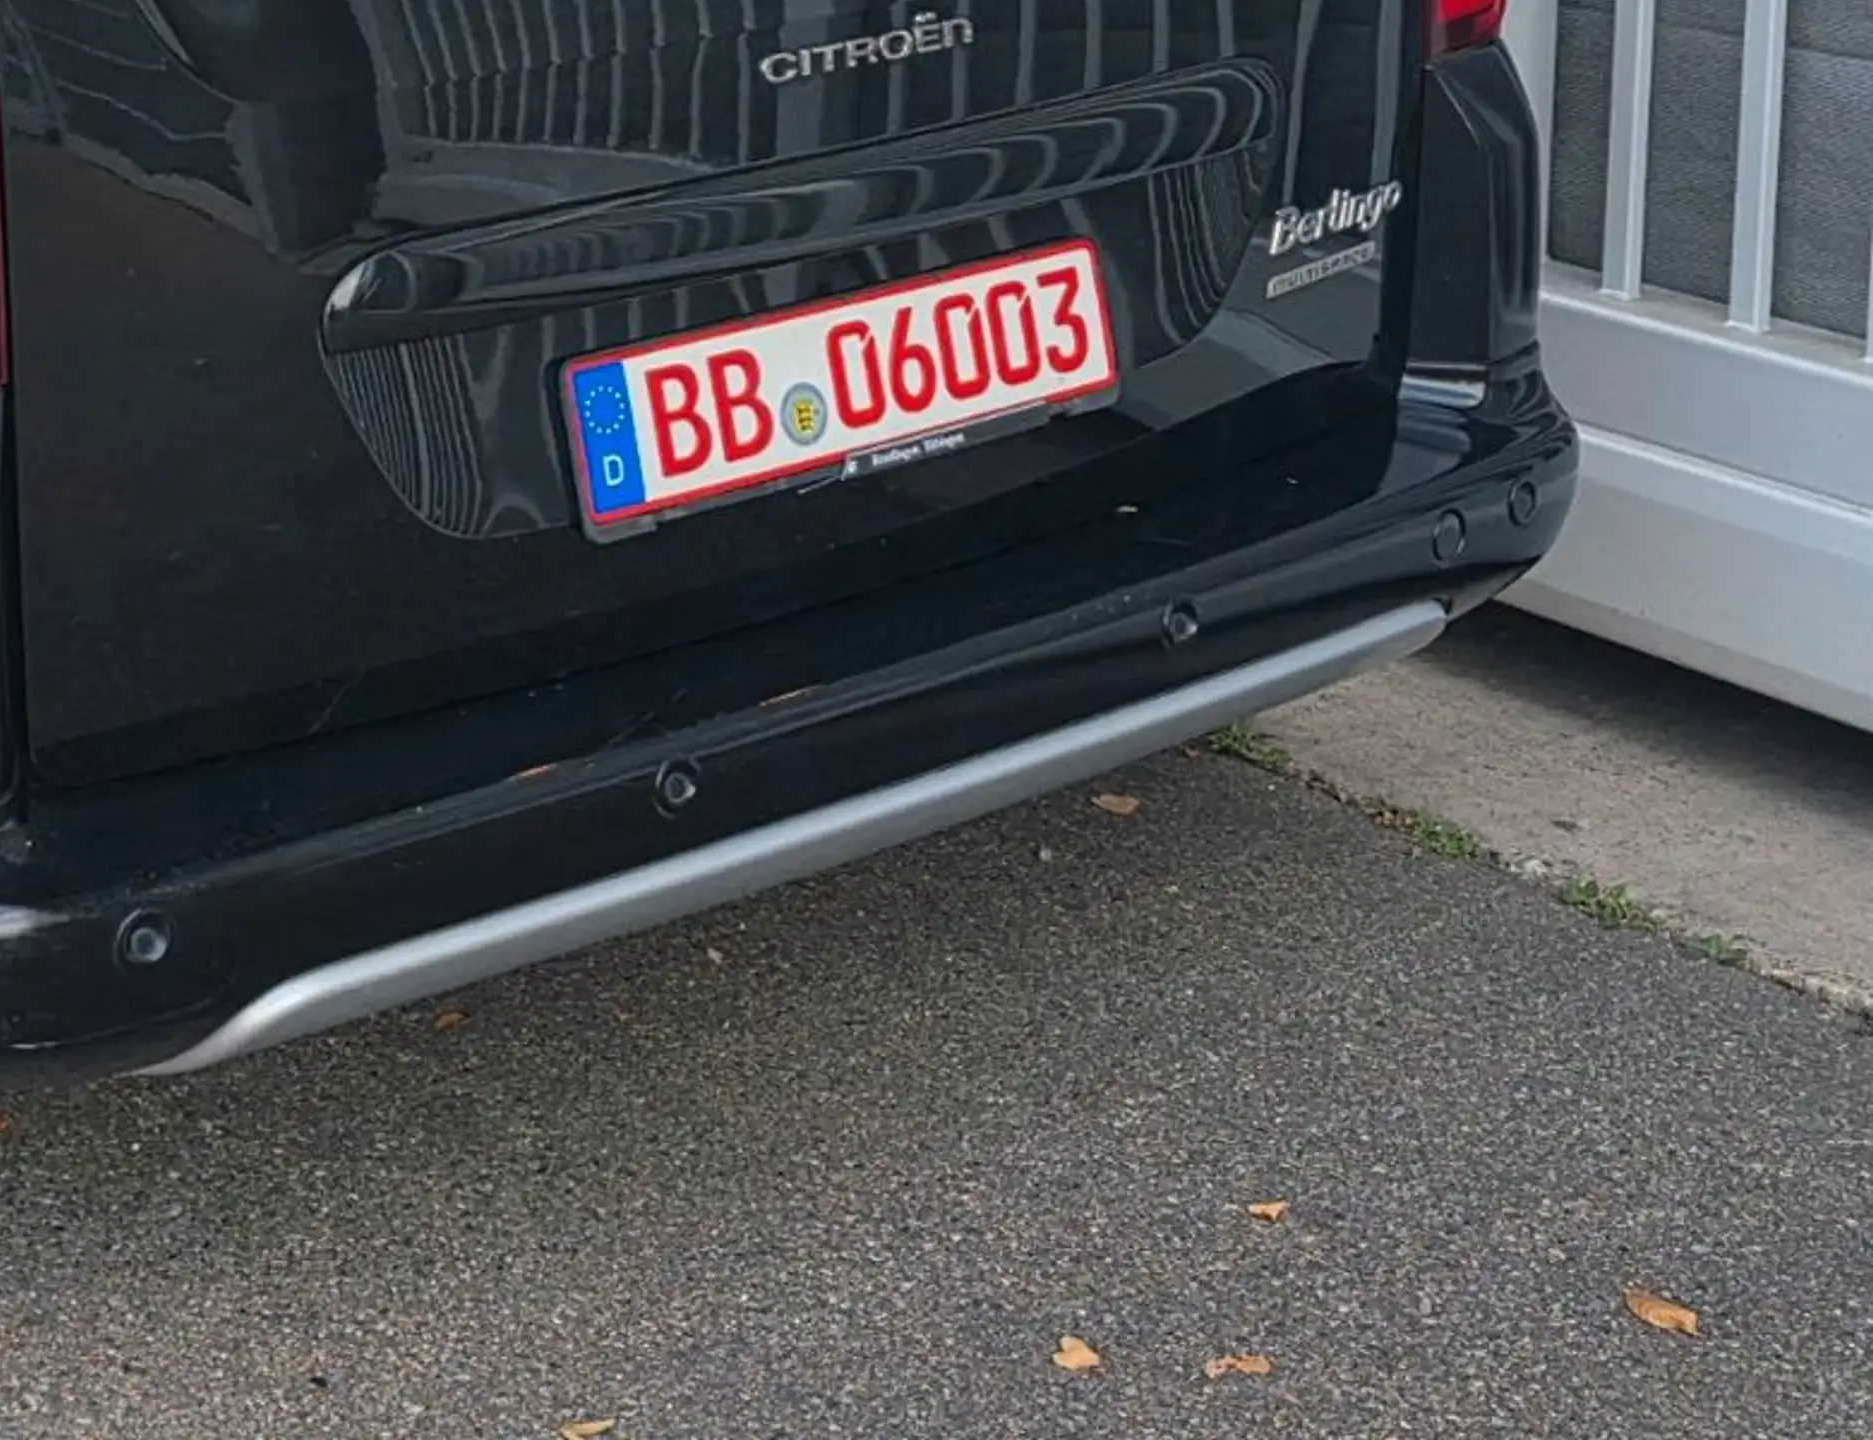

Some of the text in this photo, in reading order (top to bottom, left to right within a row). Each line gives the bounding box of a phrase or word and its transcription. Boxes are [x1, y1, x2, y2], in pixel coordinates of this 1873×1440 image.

[1269, 180, 1402, 256] Berlingo
[646, 266, 1088, 479] BB 06003
[603, 455, 625, 487] D
